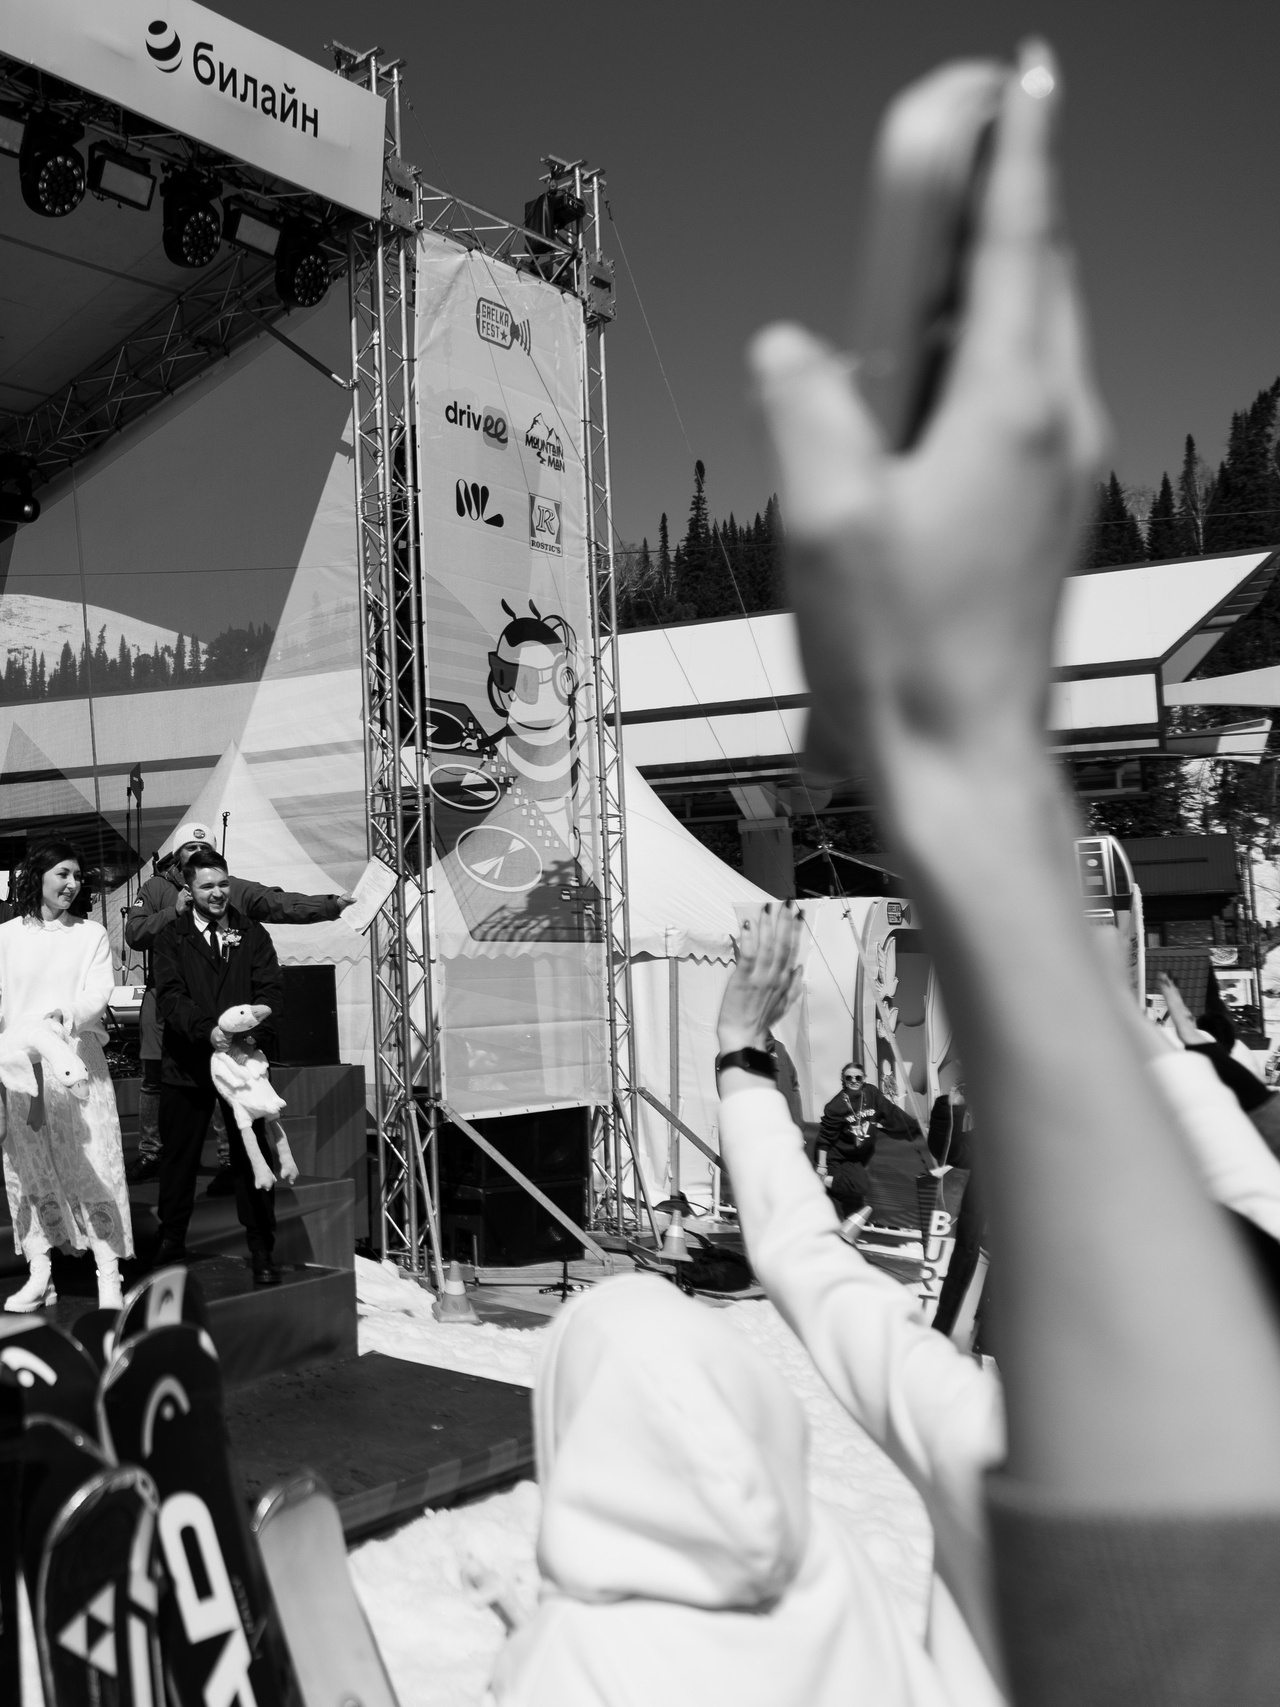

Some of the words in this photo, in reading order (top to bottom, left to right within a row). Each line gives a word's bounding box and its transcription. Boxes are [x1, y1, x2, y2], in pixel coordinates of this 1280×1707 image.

[192, 41, 318, 138] билайн
[482, 303, 509, 327] GRELKA
[482, 320, 499, 339] FEST
[445, 401, 508, 444] drivee
[525, 434, 563, 460] MOUNTAIN
[548, 455, 565, 473] MAN
[531, 540, 561, 554] ROSTIC'S
